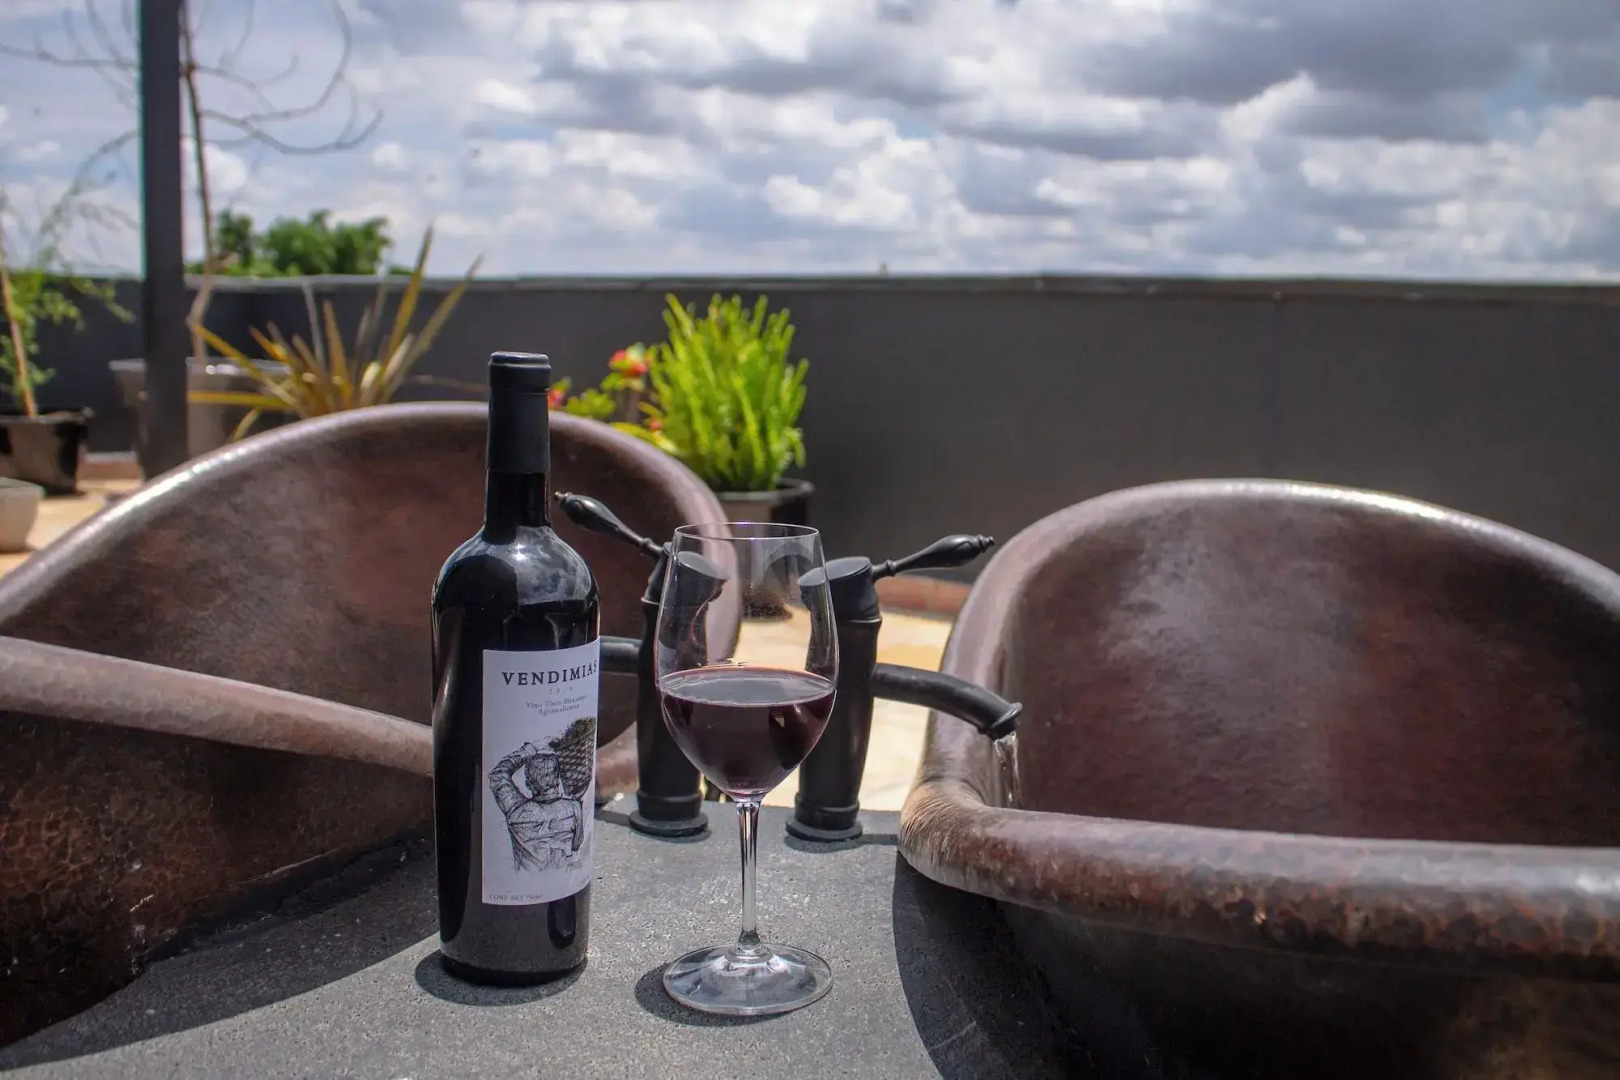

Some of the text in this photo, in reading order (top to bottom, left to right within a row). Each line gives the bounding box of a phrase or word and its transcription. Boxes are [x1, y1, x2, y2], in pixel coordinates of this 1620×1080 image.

[501, 659, 597, 686] VENDIMIAS
[526, 701, 543, 709] Vino
[545, 699, 562, 707] Tinto
